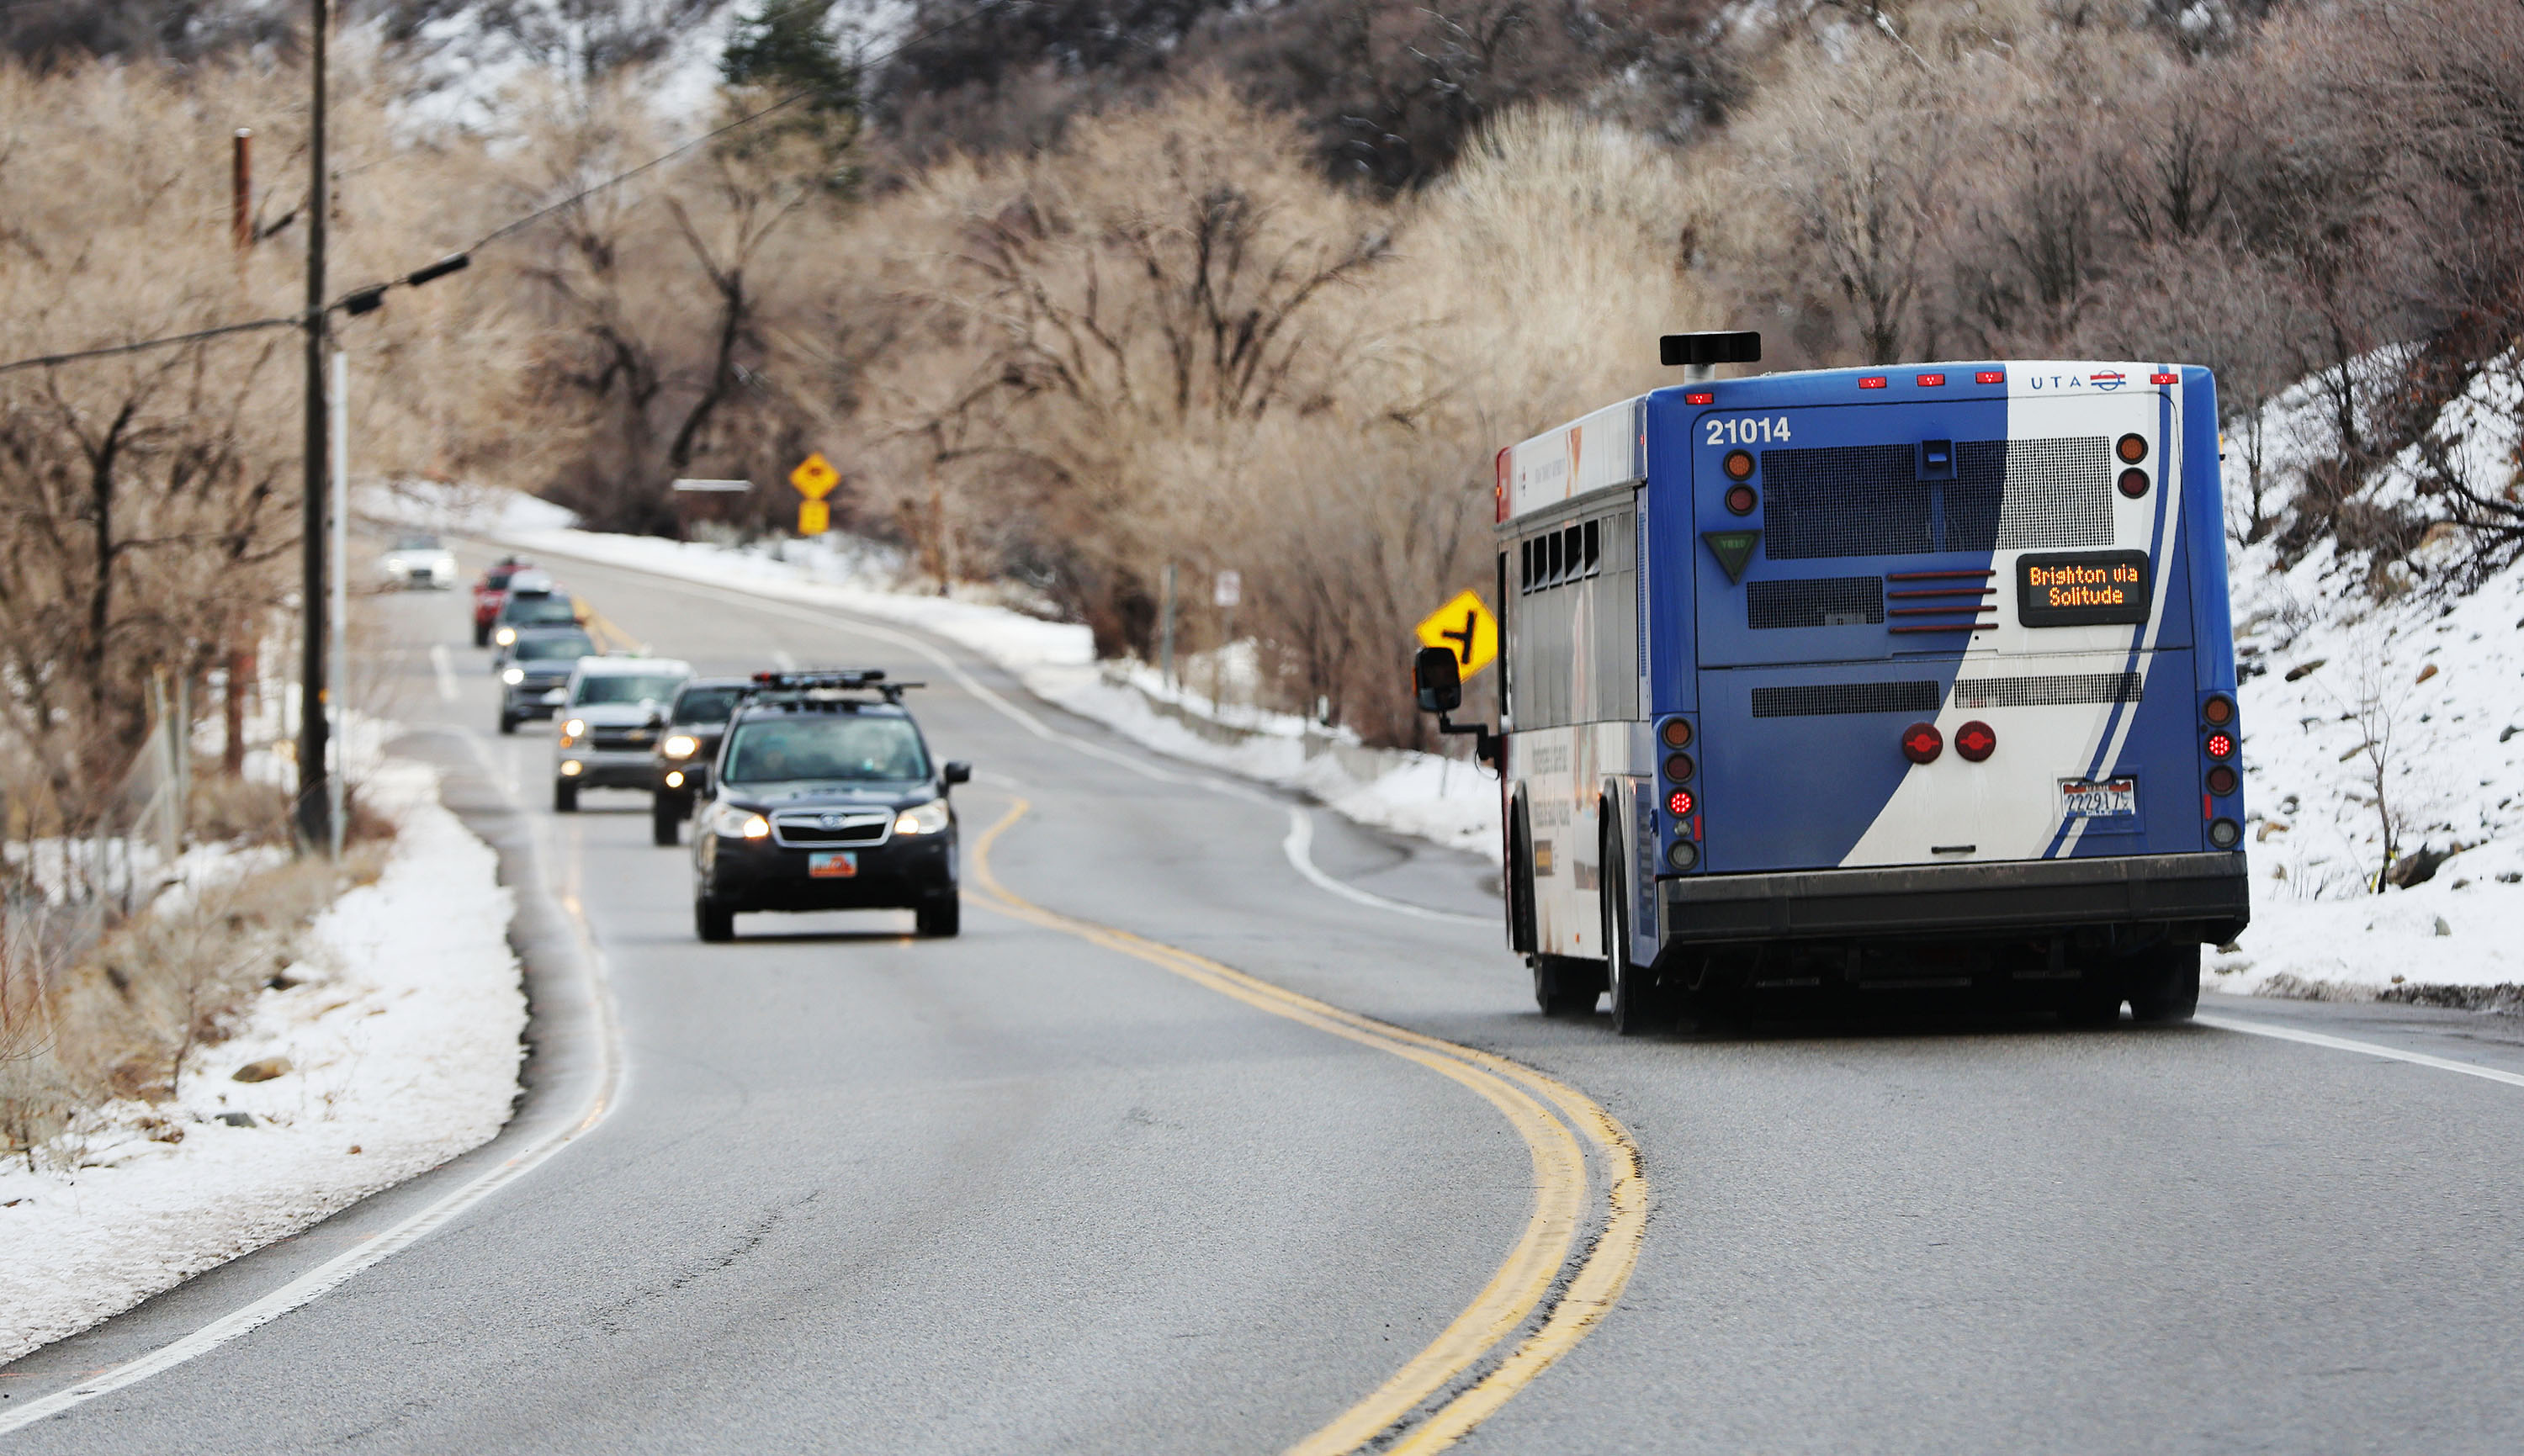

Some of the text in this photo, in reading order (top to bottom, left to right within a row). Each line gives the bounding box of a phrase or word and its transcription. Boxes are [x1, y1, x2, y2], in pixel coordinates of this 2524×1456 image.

[2031, 374, 2081, 390] UTA
[1705, 416, 1791, 445] 21014
[2029, 563, 2139, 586] Brighton via
[2049, 585, 2124, 607] Solitude
